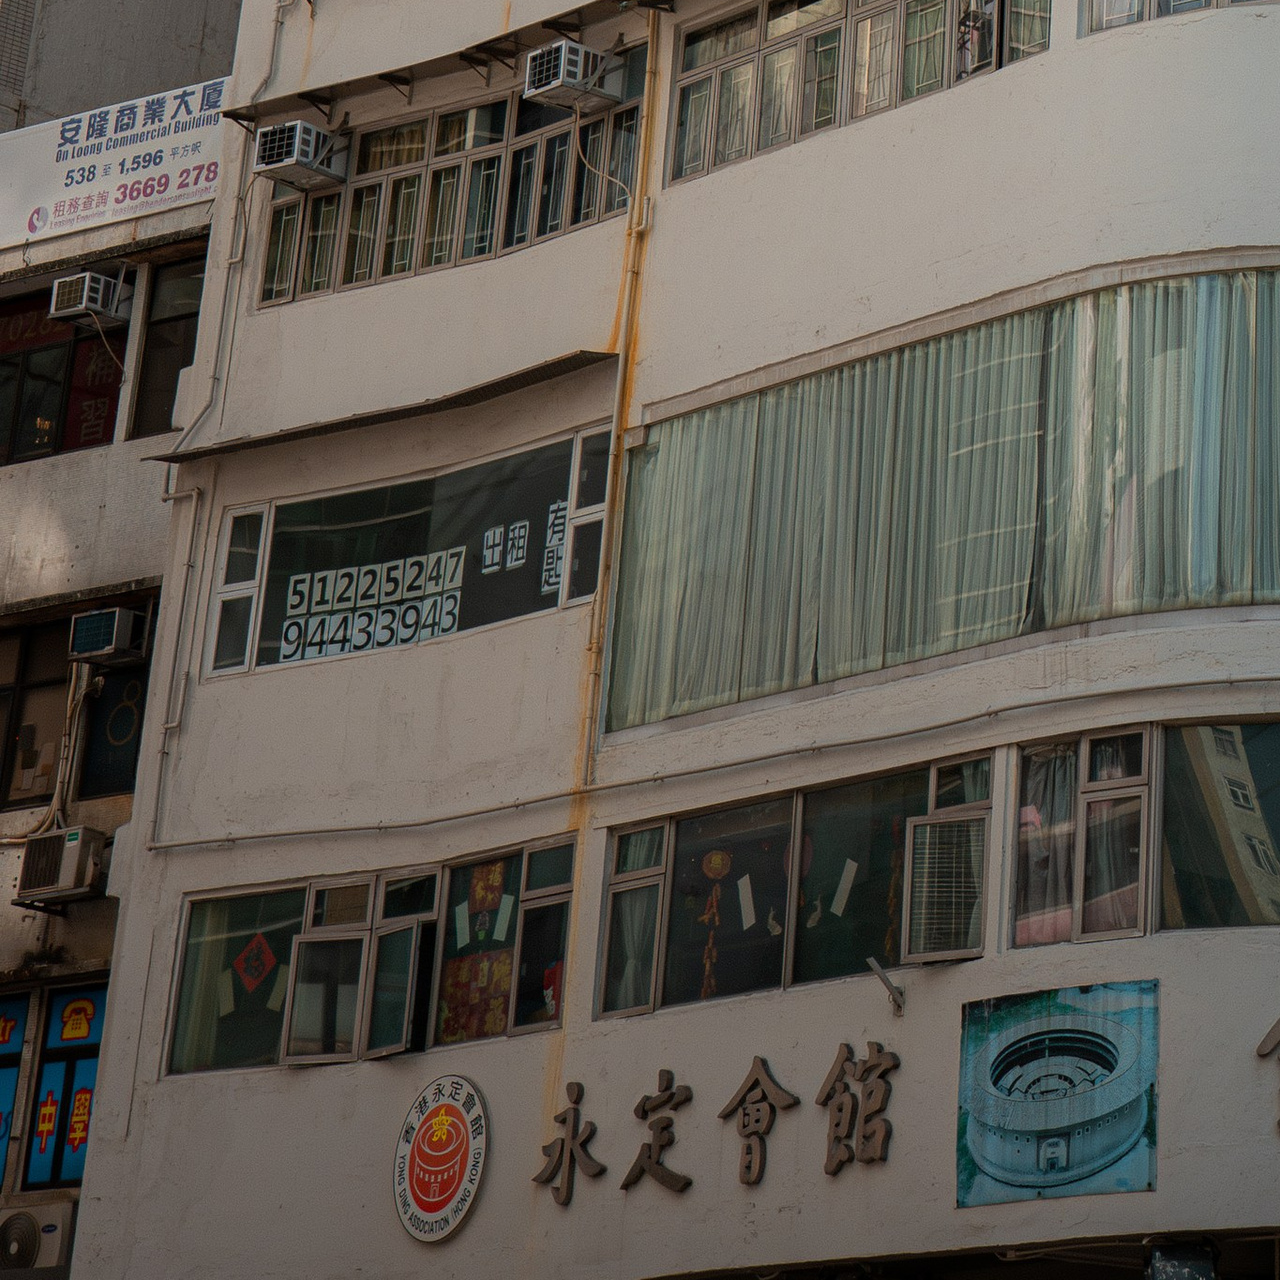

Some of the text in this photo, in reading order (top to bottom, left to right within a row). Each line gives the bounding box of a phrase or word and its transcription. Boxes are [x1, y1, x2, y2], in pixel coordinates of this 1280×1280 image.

[56, 112, 220, 163] On Loong Commercial Building
[57, 80, 225, 148] 安隆商業大廈
[52, 161, 219, 218] 租務查詢 3669 278
[64, 141, 202, 187] 538 至 1,596 平方呎
[484, 523, 527, 566] 出租
[289, 552, 463, 609] 51225247
[282, 594, 458, 659] 94433943
[402, 1080, 484, 1145] 香港永定會館
[397, 1147, 483, 1234] YONG DING ASSOCIATION (HONG KONG)
